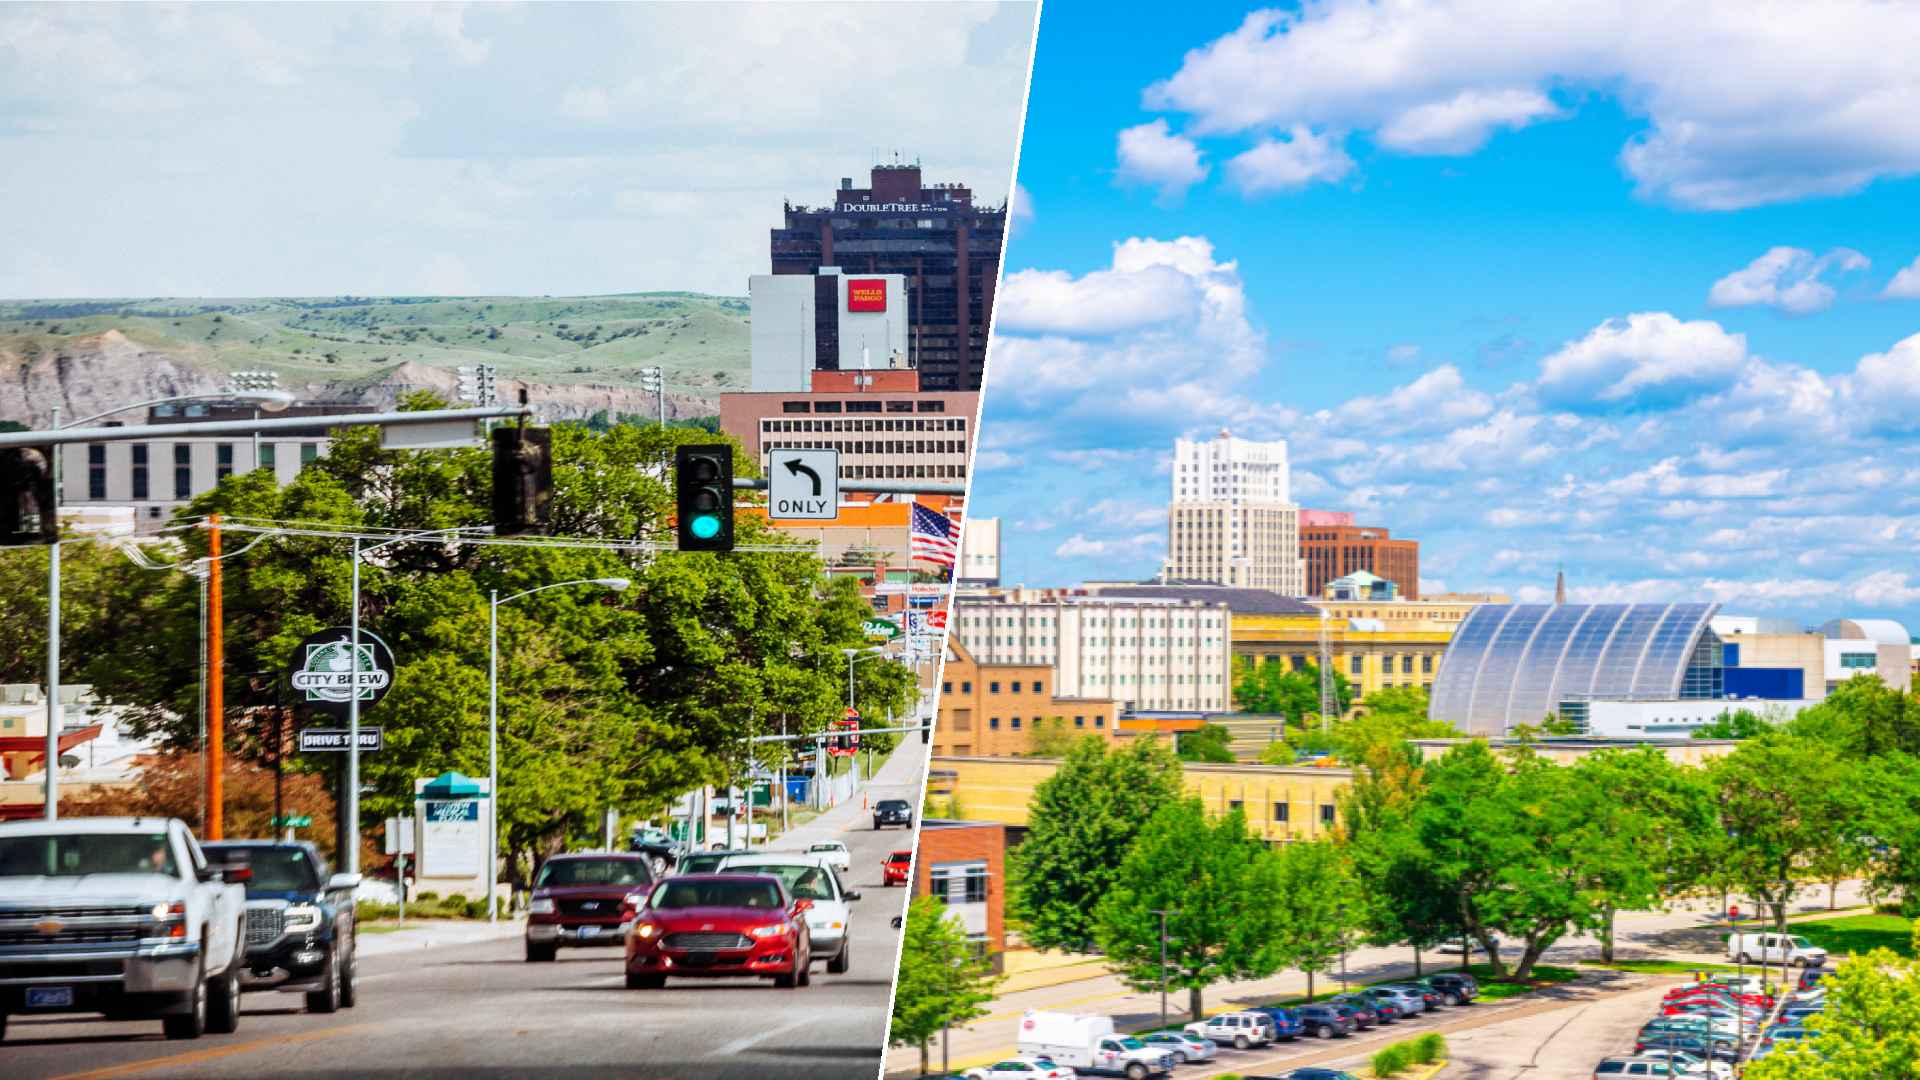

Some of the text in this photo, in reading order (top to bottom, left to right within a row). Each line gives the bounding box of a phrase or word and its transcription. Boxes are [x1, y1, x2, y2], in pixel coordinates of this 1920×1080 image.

[778, 499, 828, 513] ONLY
[296, 674, 332, 685] CITY
[303, 734, 378, 746] DRIVE TRU
